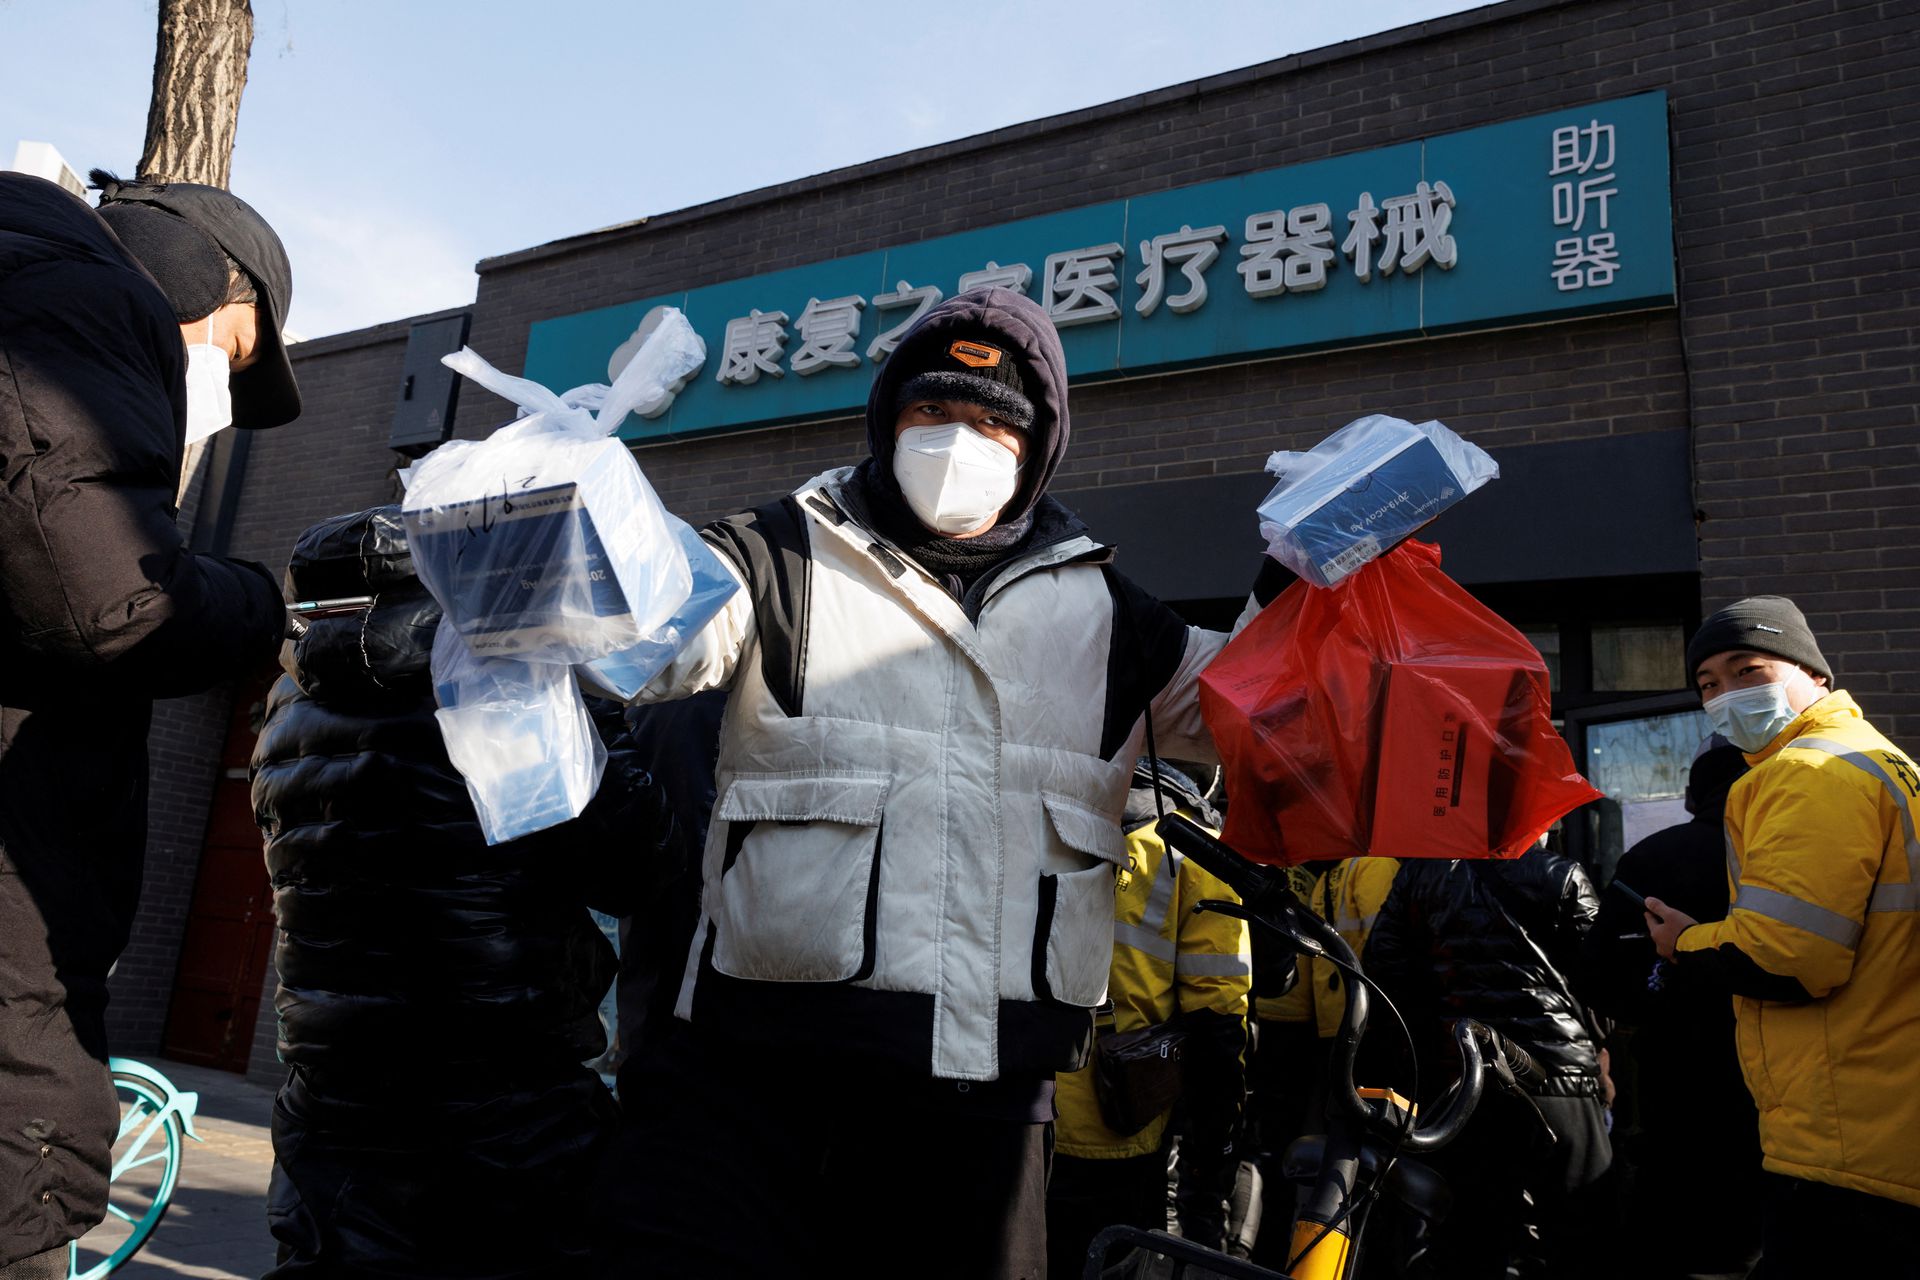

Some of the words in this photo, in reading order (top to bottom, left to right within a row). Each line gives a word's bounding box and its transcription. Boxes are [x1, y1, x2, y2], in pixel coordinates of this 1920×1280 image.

[1549, 119, 1621, 291] 助听器
[1365, 491, 1410, 526] 2019-nCoV
[1350, 523, 1364, 533] Ag
